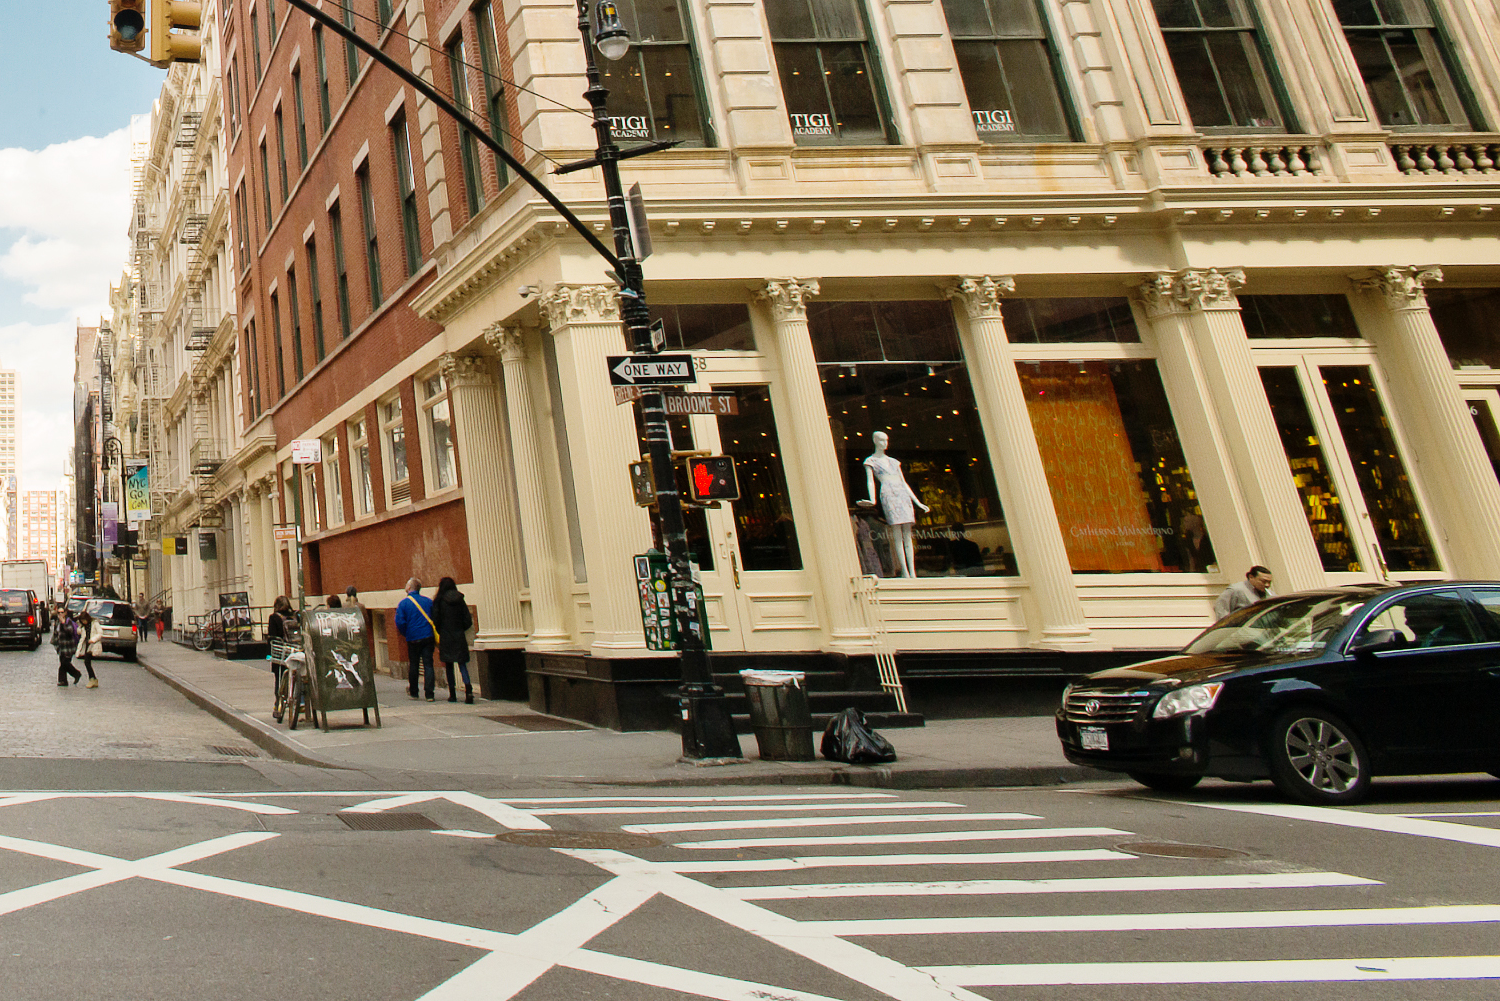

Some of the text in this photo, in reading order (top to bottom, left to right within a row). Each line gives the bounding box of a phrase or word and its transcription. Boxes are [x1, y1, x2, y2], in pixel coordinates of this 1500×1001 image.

[608, 116, 647, 130] TIGI
[790, 114, 831, 127] TIGI
[972, 110, 1014, 124] TIGI
[611, 129, 649, 137] ACADEMY
[794, 127, 832, 135] ACADEMY
[624, 363, 681, 376] ONE WAY
[668, 396, 731, 413] BROOME ST
[128, 477, 146, 490] NYC
